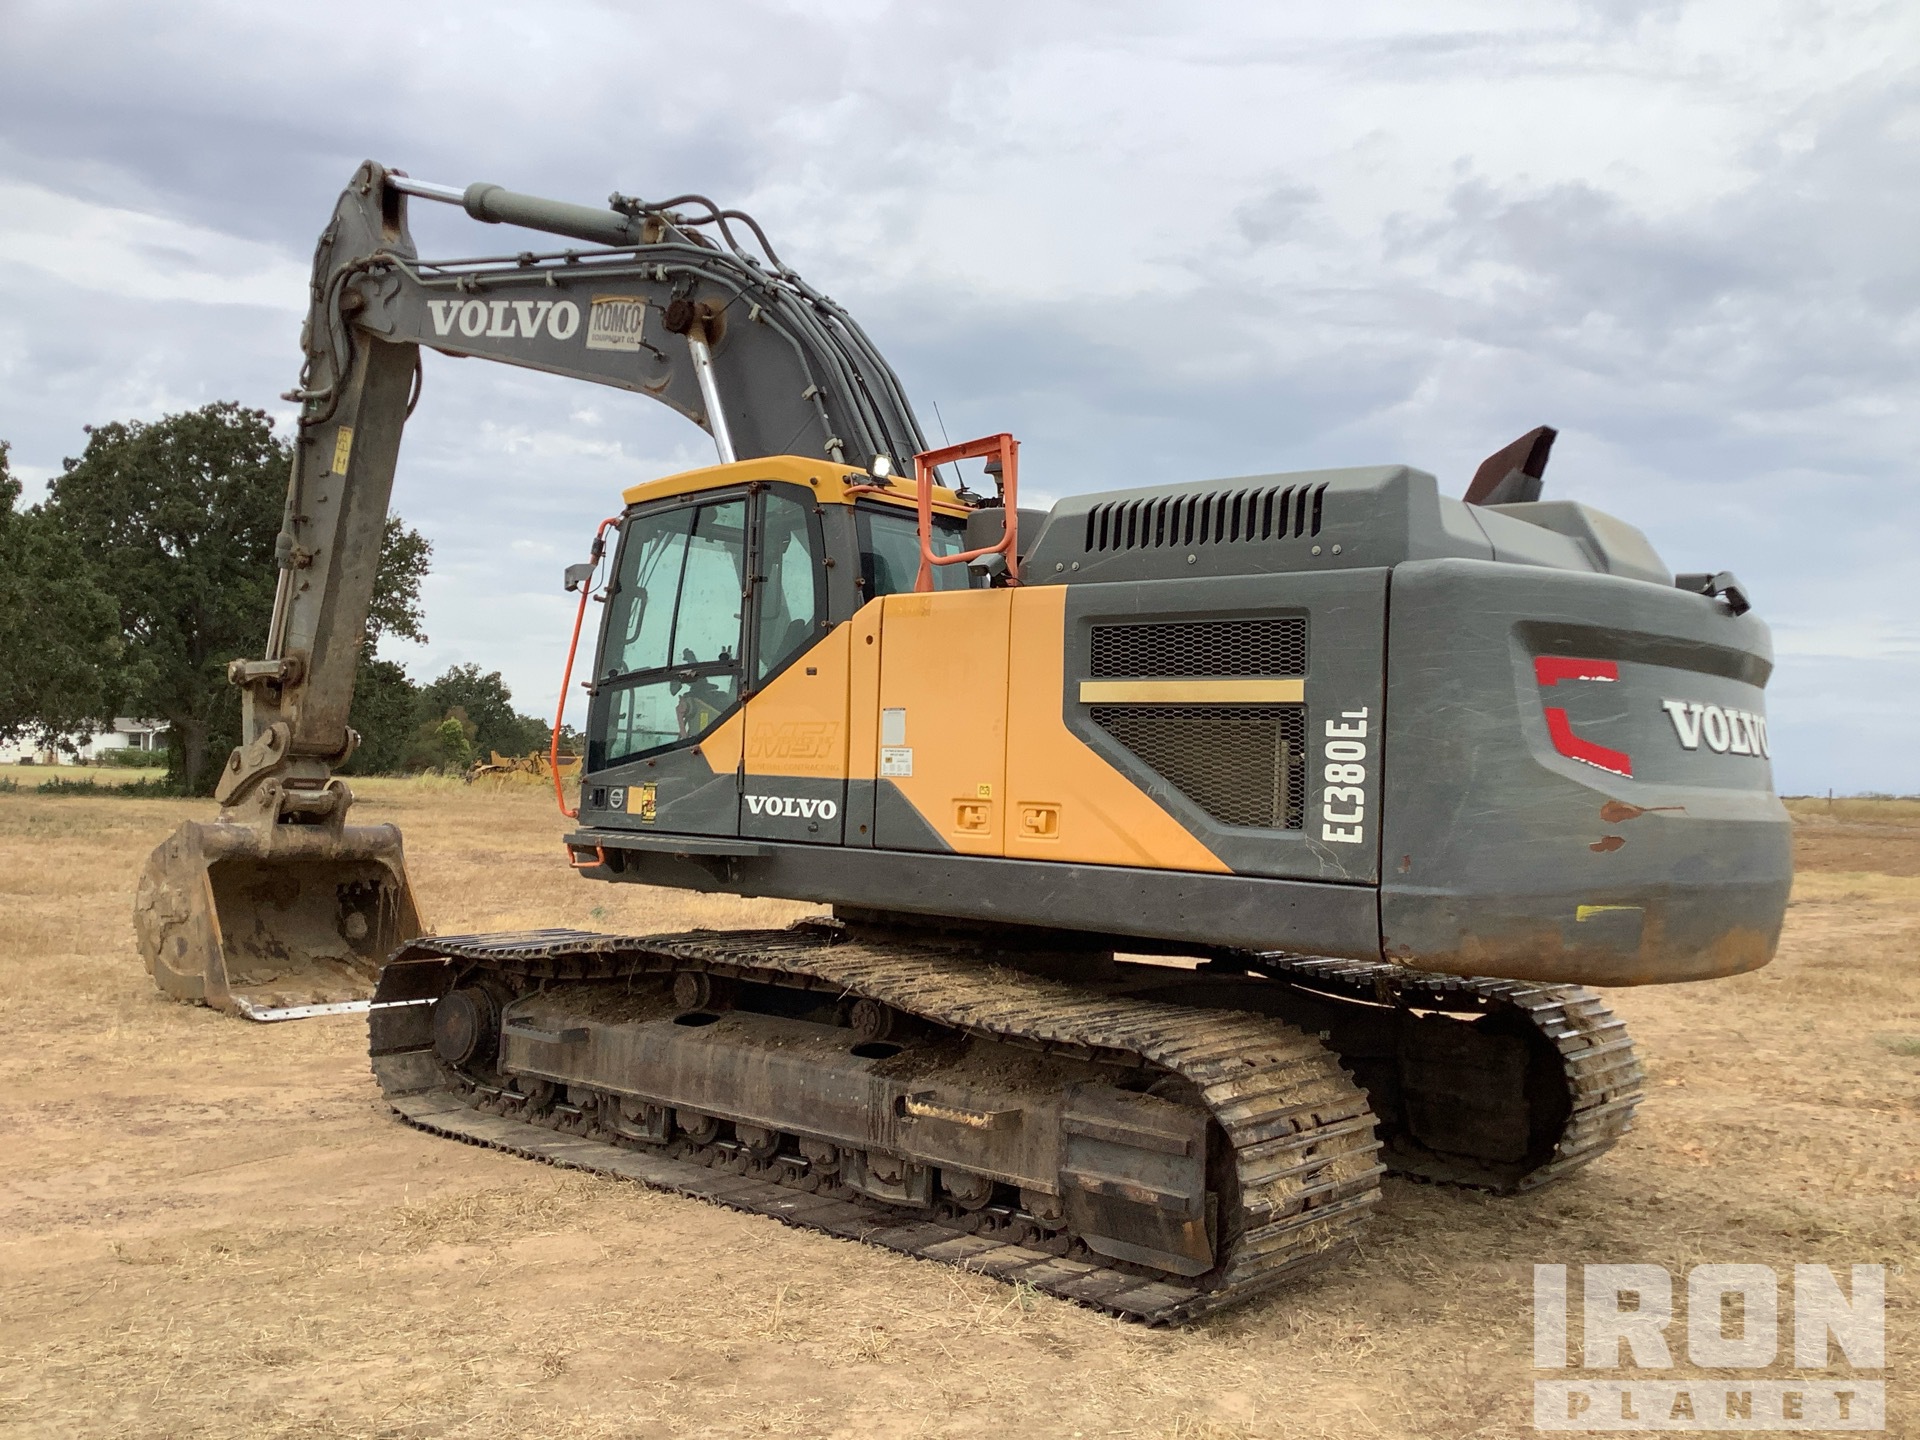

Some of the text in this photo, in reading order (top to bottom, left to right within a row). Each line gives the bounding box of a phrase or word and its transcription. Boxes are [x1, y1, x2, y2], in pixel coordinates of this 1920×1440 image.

[427, 300, 580, 340] VOLVO
[594, 303, 641, 334] ROMCO
[591, 334, 625, 343] EQUIPMENT
[1662, 699, 1769, 759] VOLVO
[1322, 706, 1368, 844] EC380EL
[744, 795, 837, 819] VOLVO
